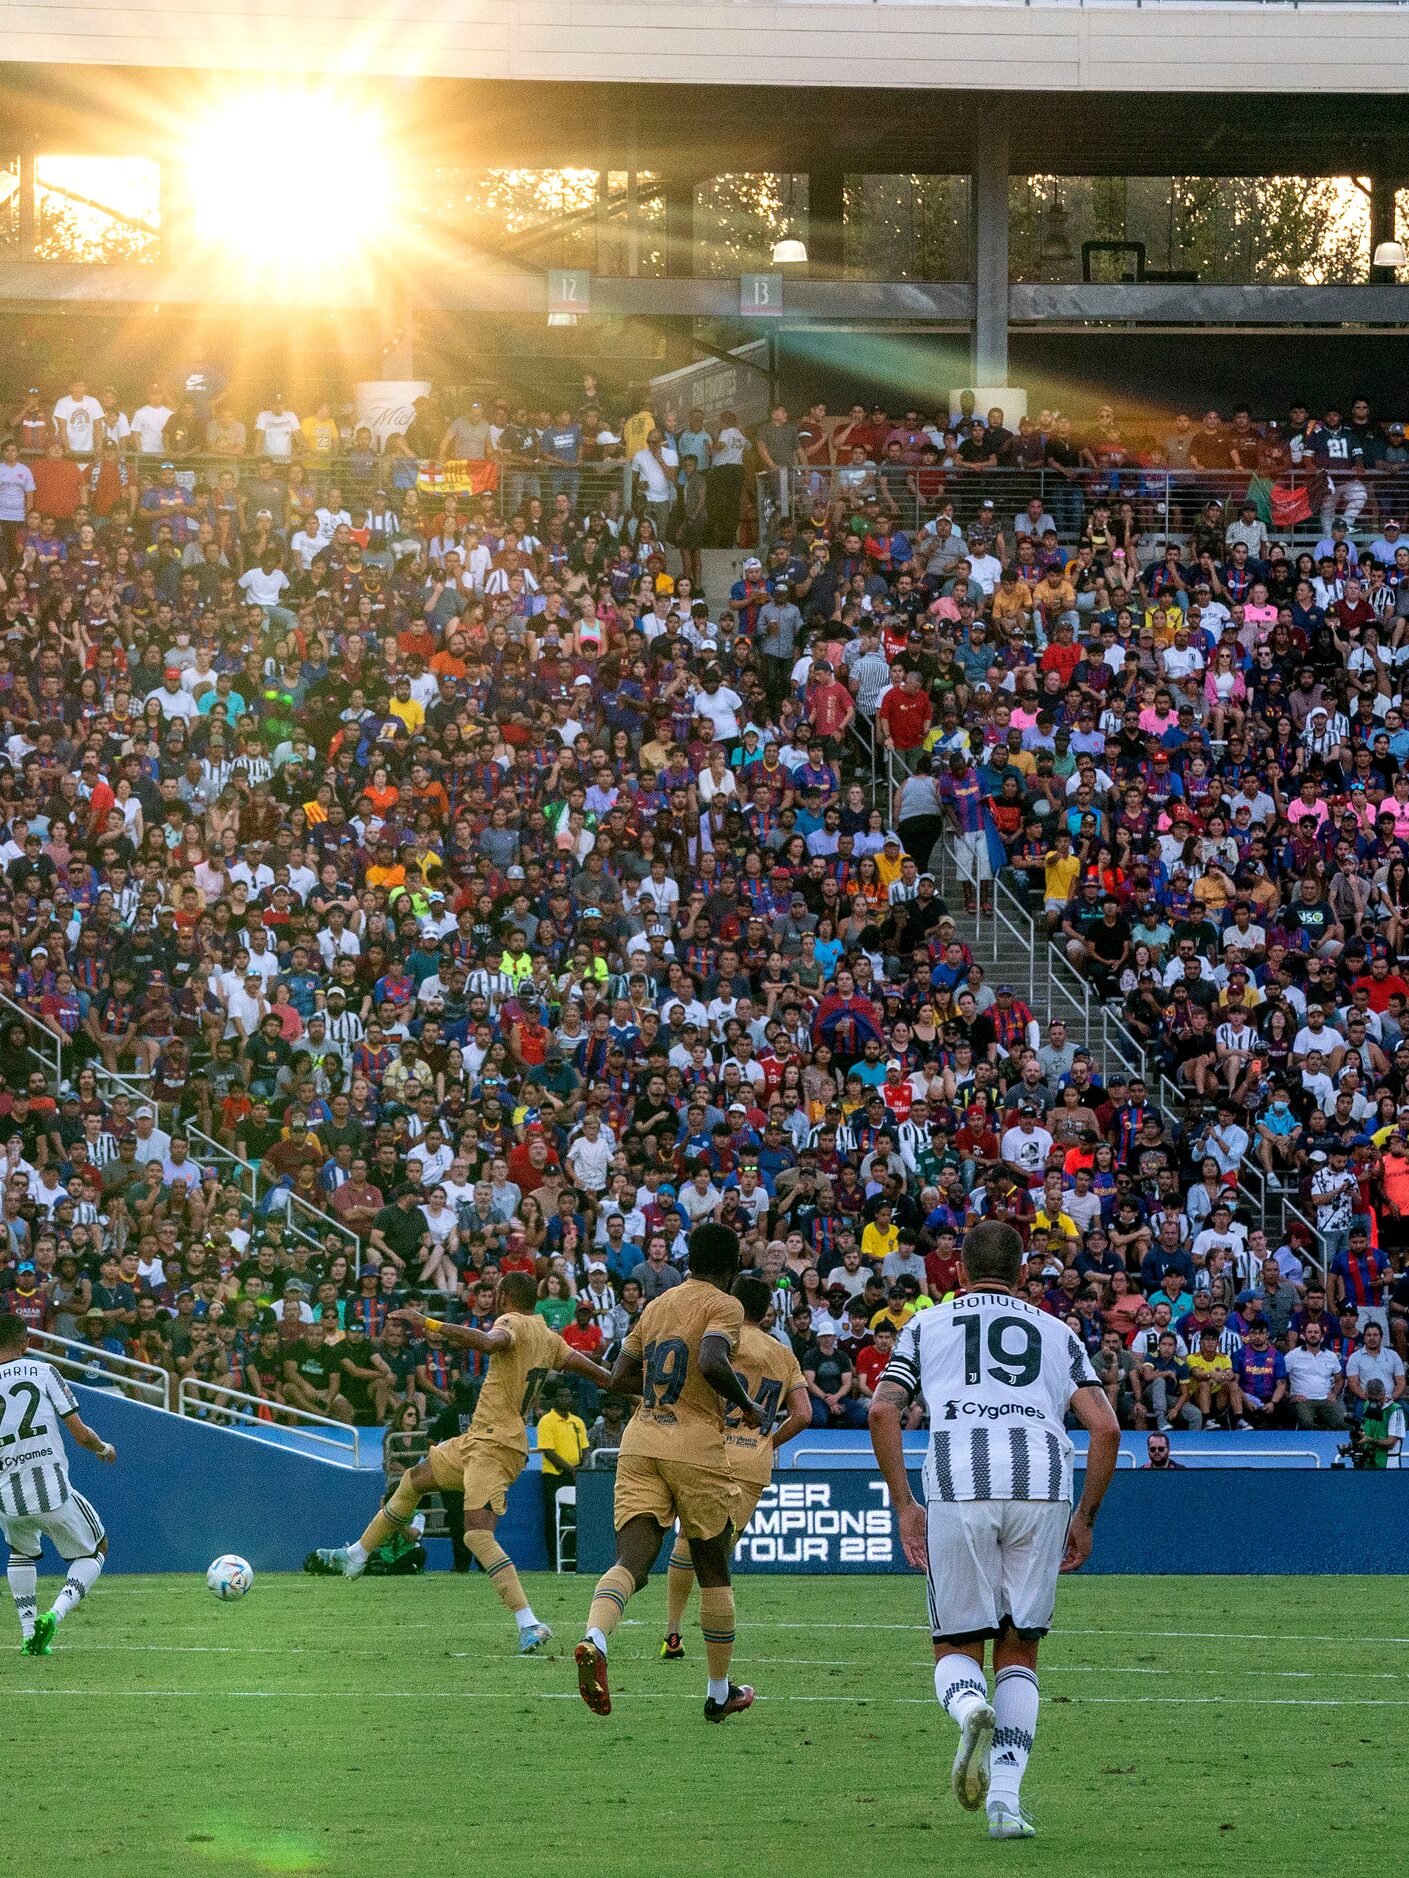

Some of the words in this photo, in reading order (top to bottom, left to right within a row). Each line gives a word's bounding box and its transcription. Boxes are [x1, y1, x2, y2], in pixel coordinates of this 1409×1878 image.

[561, 278, 577, 302] 12
[753, 282, 769, 305] 13
[1327, 438, 1348, 459] 21
[435, 1155, 444, 1165] H
[16, 1307, 40, 1315] QATAR
[952, 1313, 1042, 1387] 19
[642, 1338, 689, 1409] 19
[1245, 1366, 1272, 1375] Rakuten
[961, 1401, 1046, 1420] Cygames
[4, 1446, 54, 1468] Cygames
[755, 1483, 831, 1509] CER
[734, 1537, 829, 1562] TOUR
[839, 1537, 893, 1562] 22
[993, 1758, 1020, 1768] adidas
